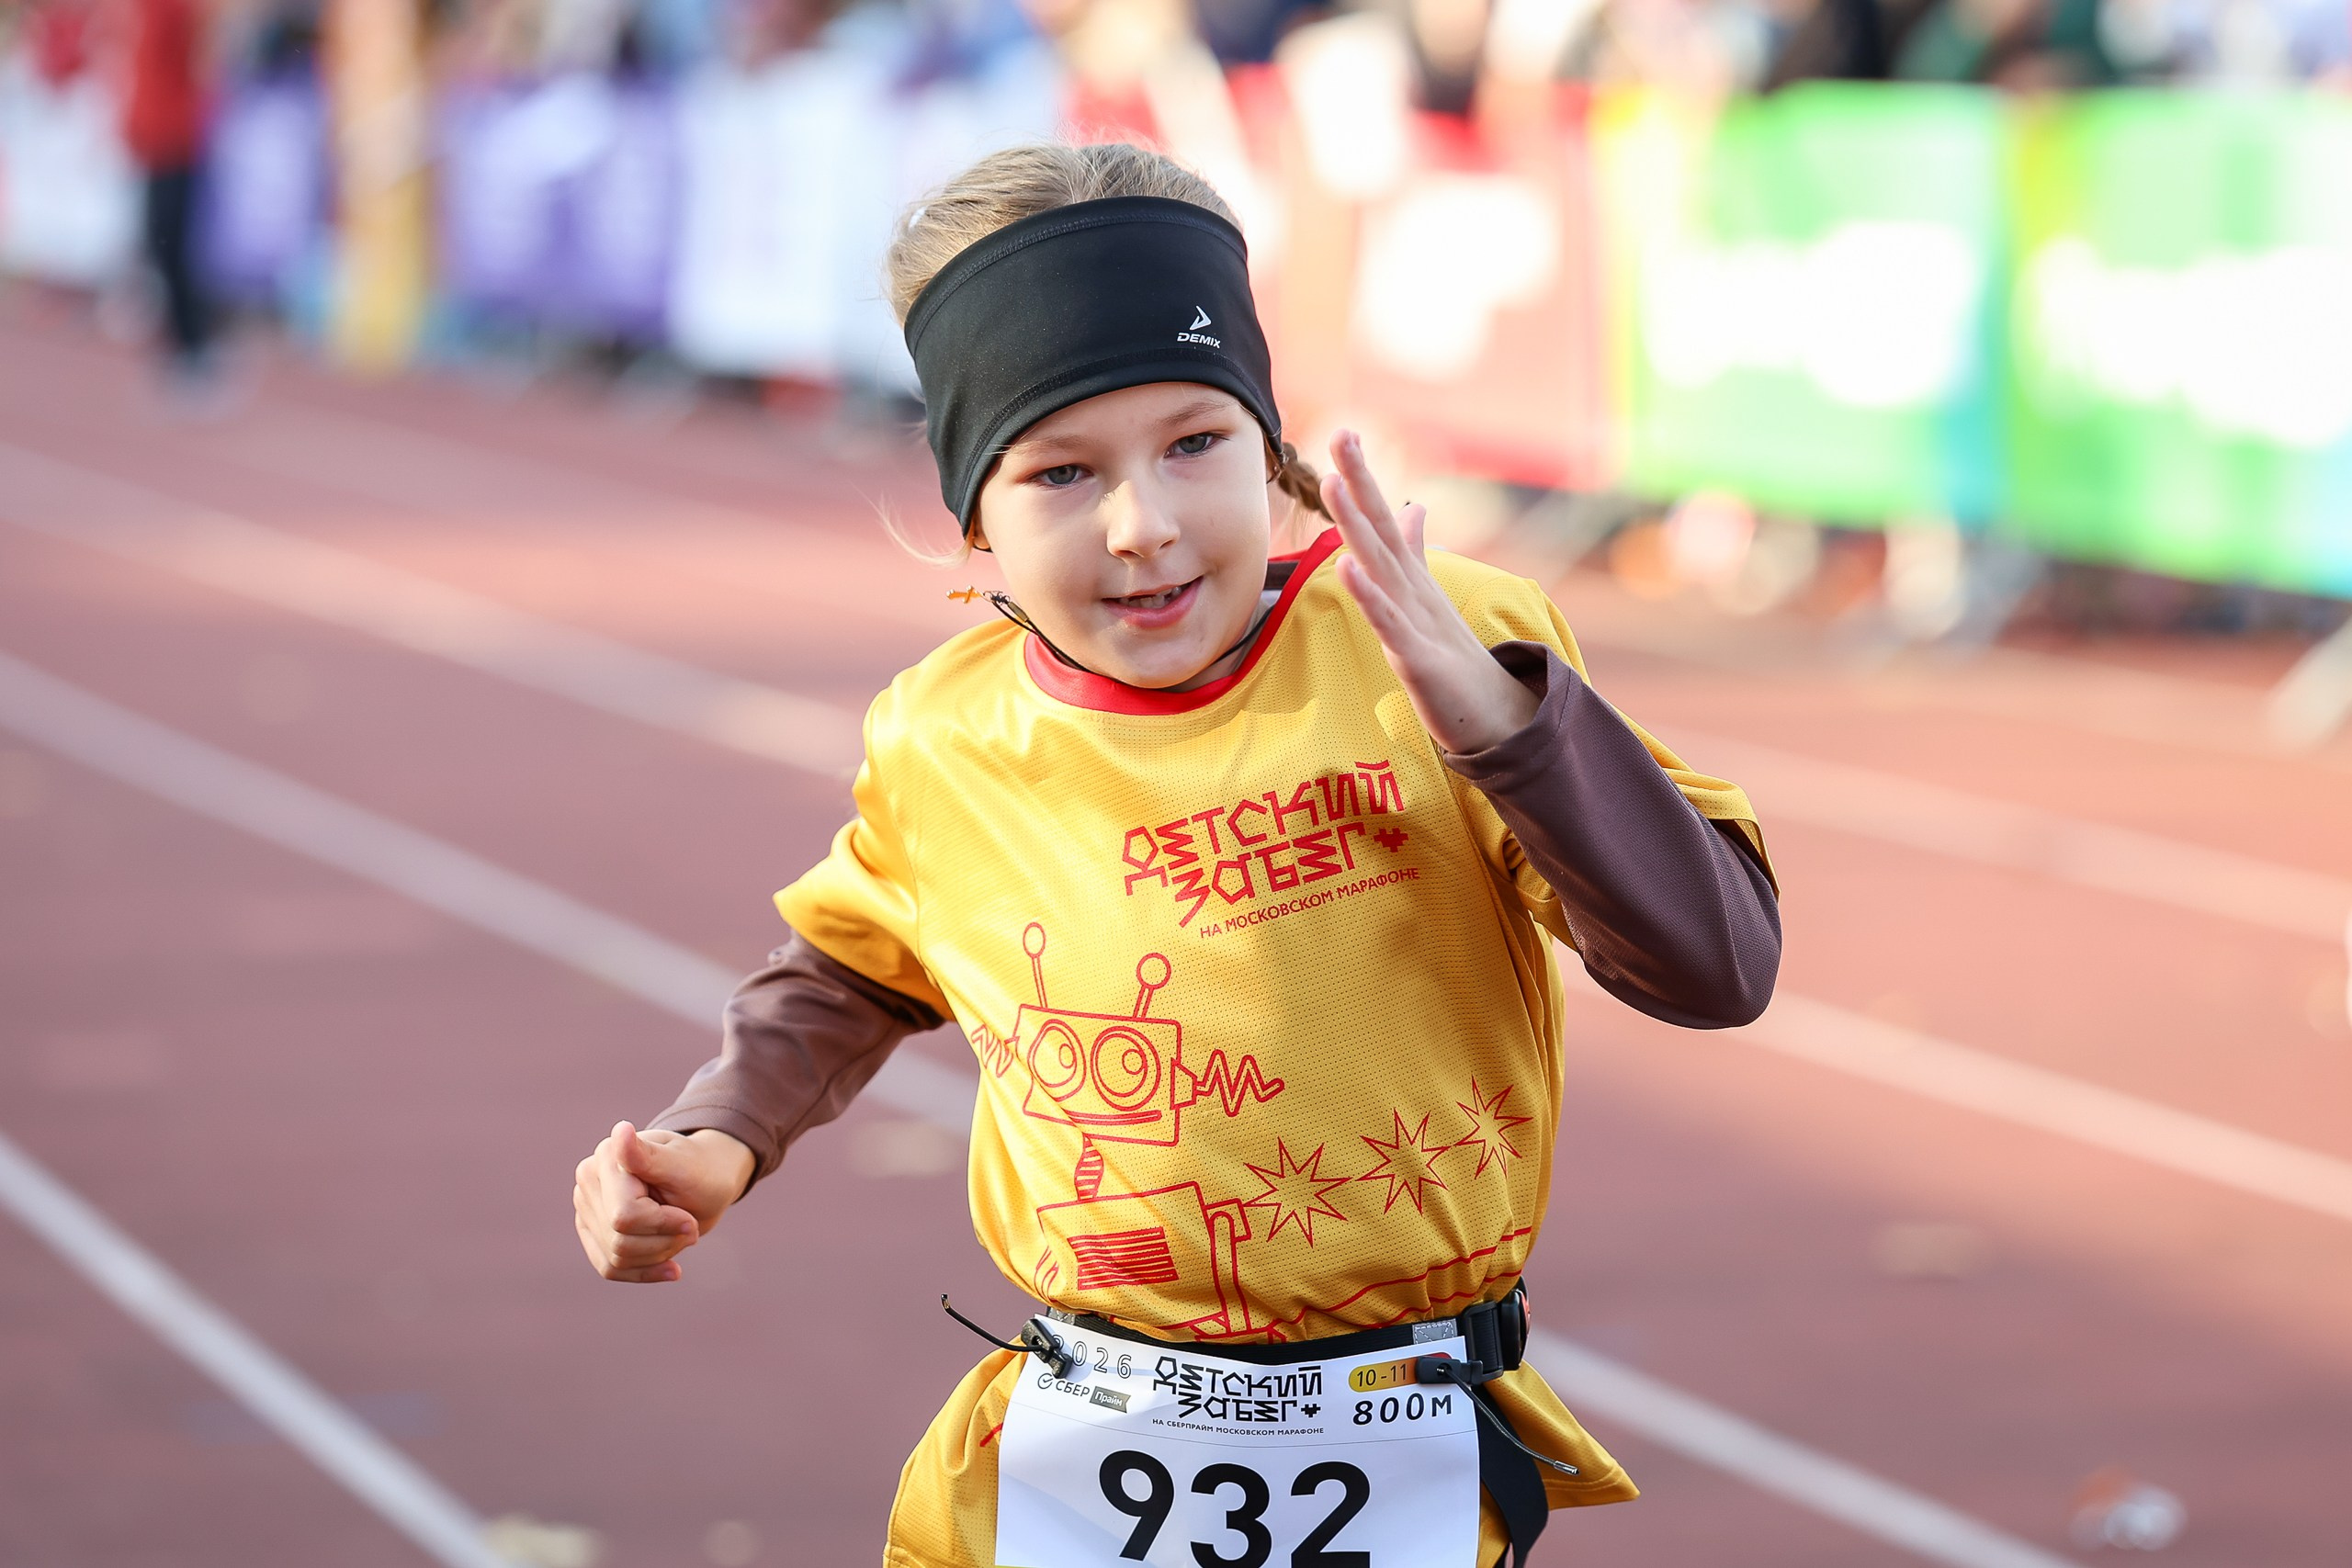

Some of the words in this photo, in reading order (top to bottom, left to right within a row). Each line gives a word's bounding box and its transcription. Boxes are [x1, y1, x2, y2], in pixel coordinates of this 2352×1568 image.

[1177, 333, 1220, 348] DEMIX
[1122, 760, 1405, 896] ДЕТСКИЙ
[1200, 923, 1222, 939] НА
[1225, 891, 1334, 932] МОСКОВСКОМ
[1337, 867, 1420, 898] МАРАФОНЕ
[1153, 1356, 1322, 1397] ДЕТСКИЙ
[1357, 1363, 1407, 1387] 10-11
[1056, 1380, 1091, 1397] СБЕР
[1094, 1391, 1123, 1406] Прайм
[1166, 1420, 1214, 1432] СБЕРПРАЙМ
[1216, 1427, 1275, 1436] МОСКОВСКОМ
[1099, 1450, 1372, 1568] 932
